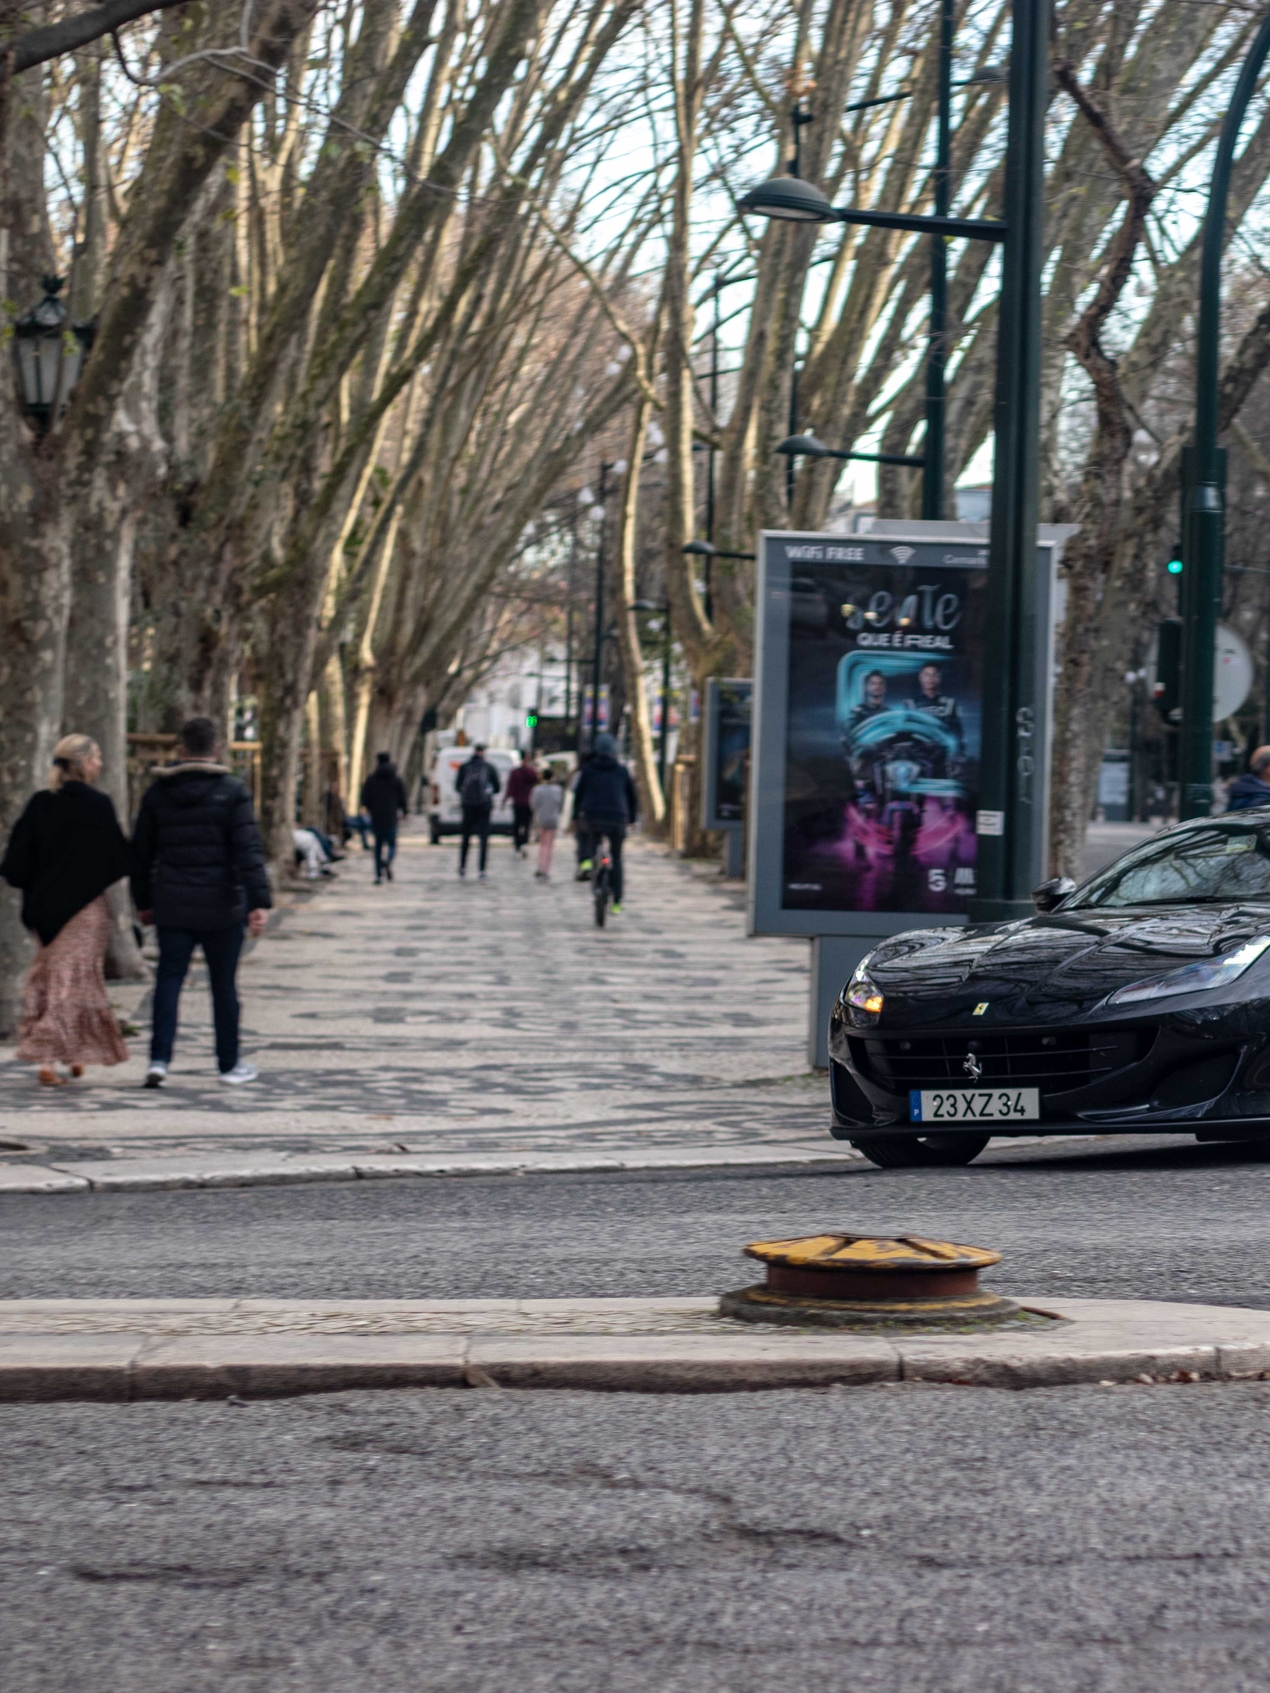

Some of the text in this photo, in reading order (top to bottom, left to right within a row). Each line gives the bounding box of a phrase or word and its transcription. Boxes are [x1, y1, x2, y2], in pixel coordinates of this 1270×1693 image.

[785, 545, 865, 561] WiFi FREE
[856, 632, 891, 647] QUE
[891, 630, 903, 647] É
